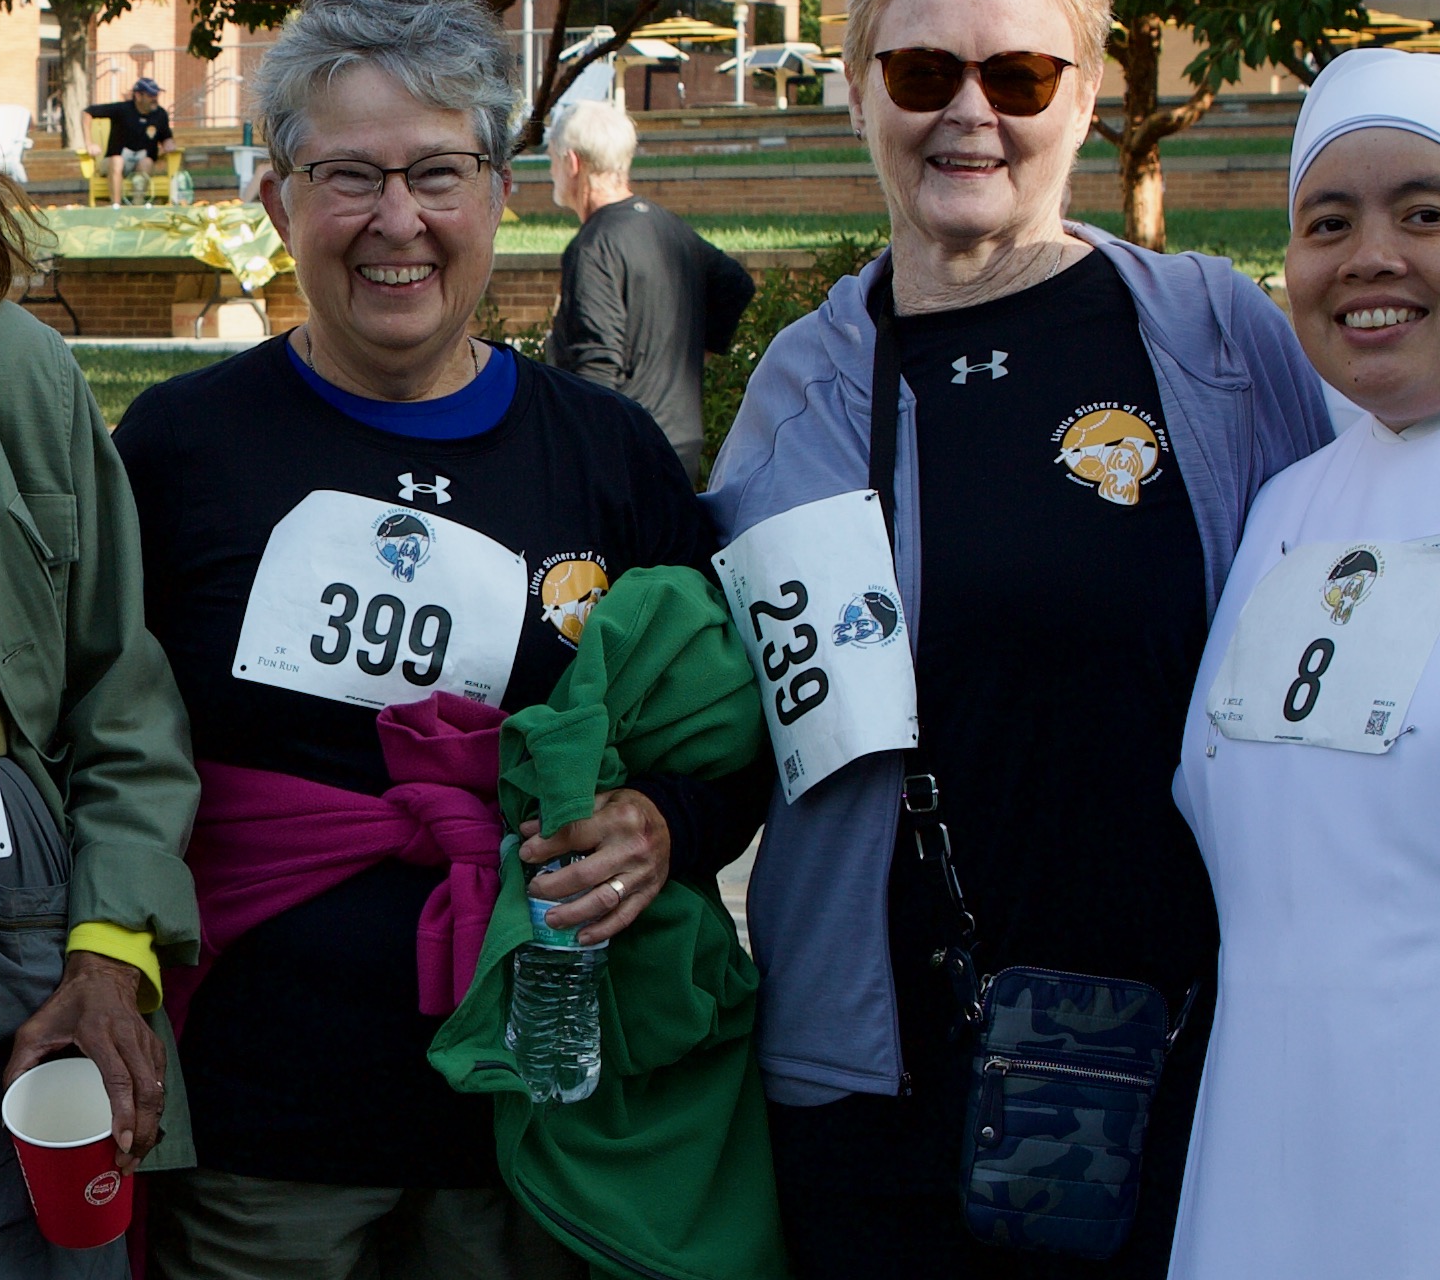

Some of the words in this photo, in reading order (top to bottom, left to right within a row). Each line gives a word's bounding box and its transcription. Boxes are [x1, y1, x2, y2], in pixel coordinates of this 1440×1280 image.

[1050, 416, 1075, 442] Little
[1075, 402, 1119, 417] Sisters
[1123, 404, 1137, 414] of
[1139, 411, 1156, 427] the
[1155, 429, 1169, 453] Poor
[530, 568, 545, 596] Little
[542, 552, 576, 569] Sisters
[580, 550, 593, 561] of
[595, 555, 607, 571] th
[274, 646, 287, 655] 5K
[310, 582, 453, 687] 399
[748, 580, 829, 726] 239
[257, 656, 277, 669] FUN
[279, 660, 300, 673] RUN
[1283, 638, 1335, 722] 8
